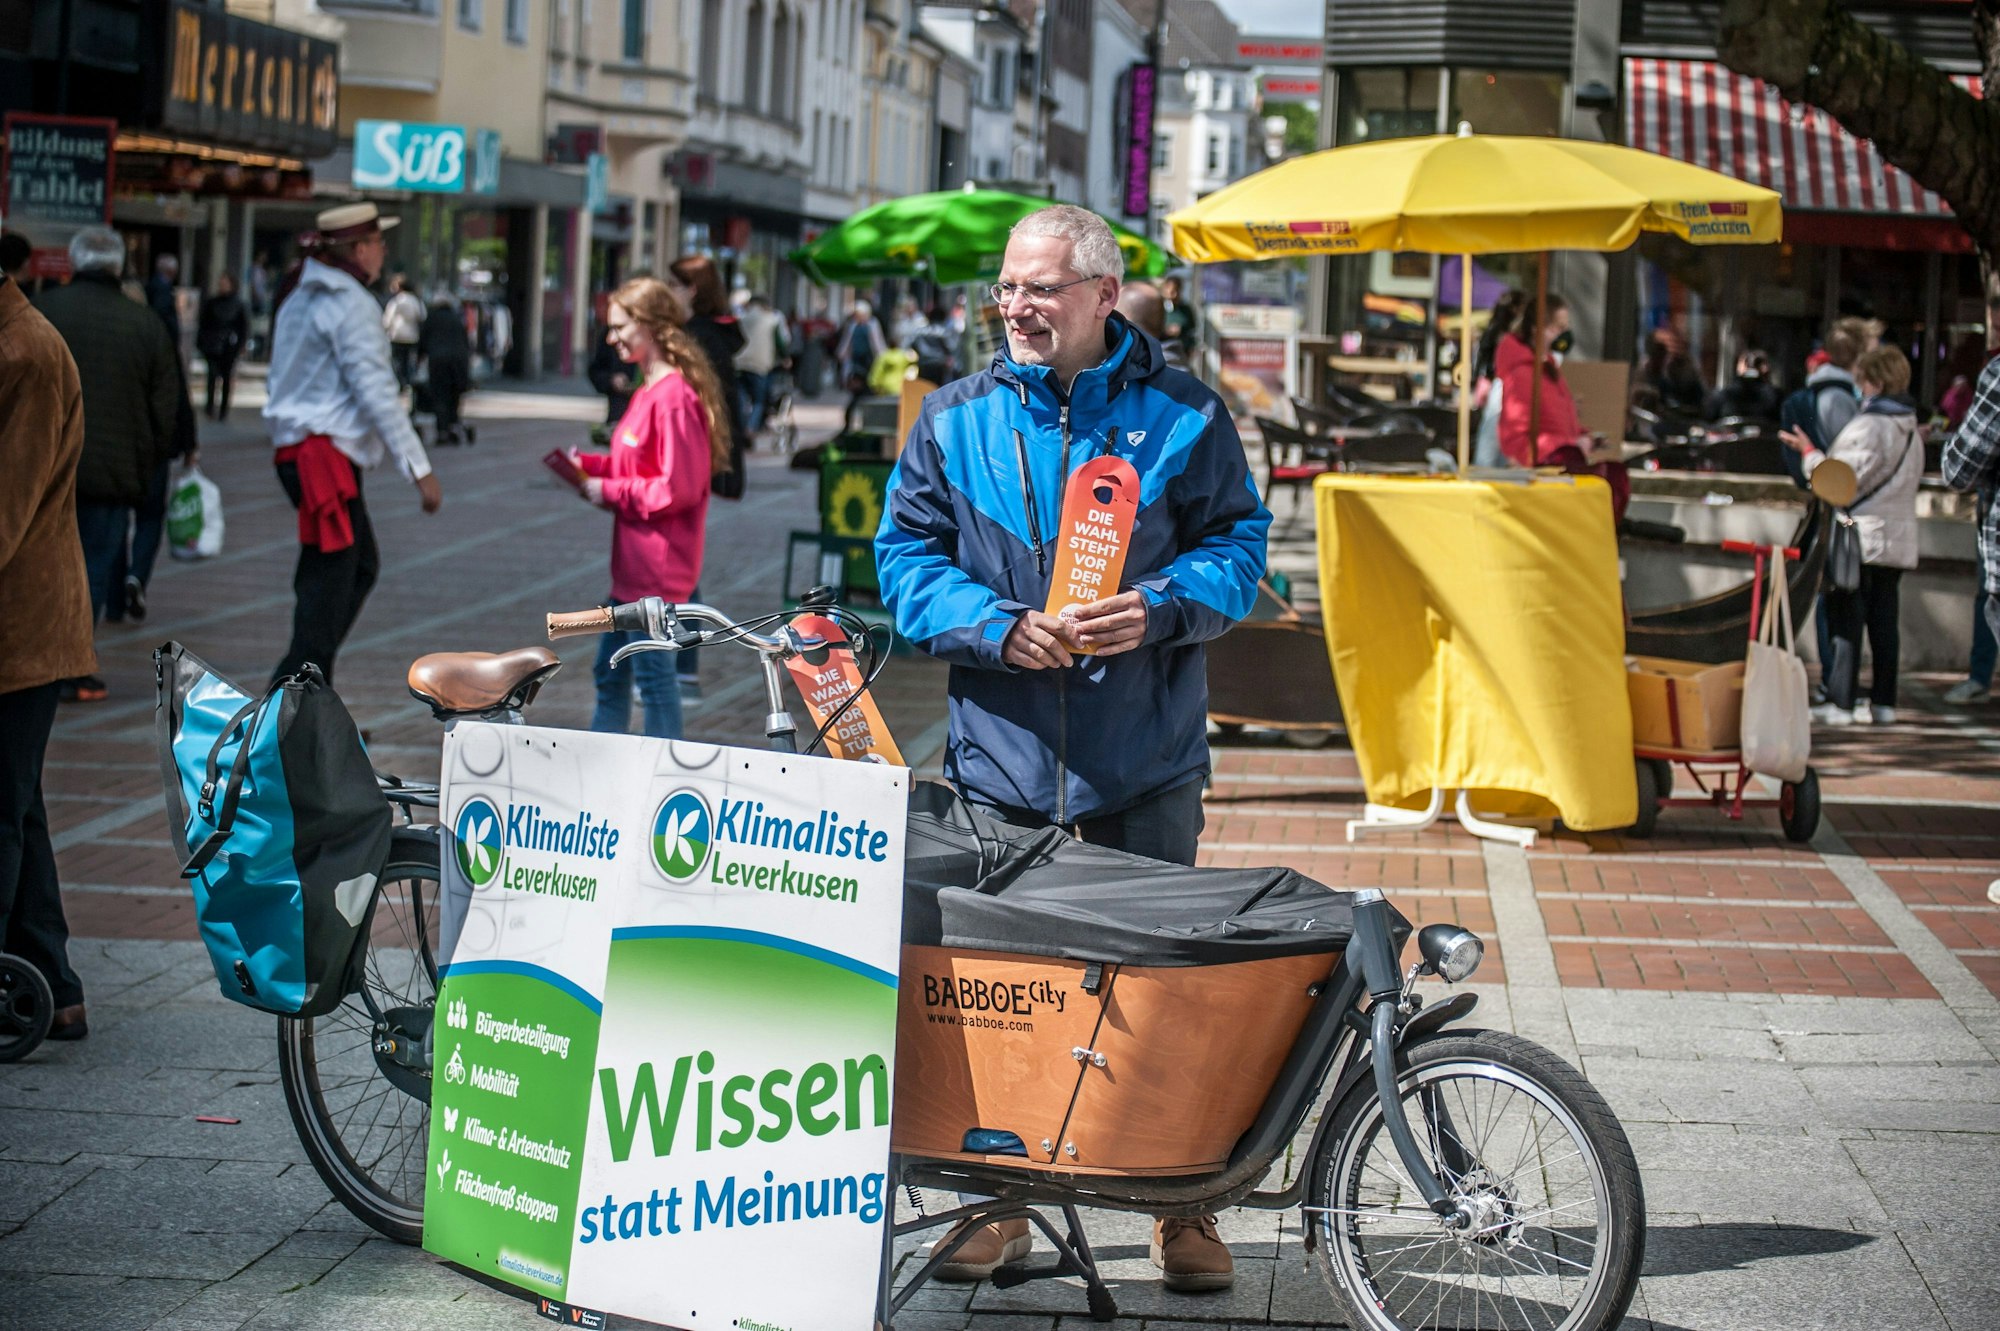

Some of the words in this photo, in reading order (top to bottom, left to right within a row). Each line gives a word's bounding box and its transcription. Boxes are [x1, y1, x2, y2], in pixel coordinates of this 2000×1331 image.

[9, 128, 106, 162] Bildung
[351, 122, 464, 187] Süß
[8, 171, 105, 207] Tablet
[1074, 521, 1121, 544] WAHL
[1088, 509, 1115, 526] DIE
[1069, 536, 1120, 559] STEHT
[1074, 552, 1108, 572] VOR
[1067, 583, 1099, 602] TÜR
[1070, 567, 1103, 586] DER
[811, 679, 857, 703] WAHL
[814, 668, 840, 686] DIE
[838, 720, 869, 740] DER
[844, 735, 876, 754] TÜR
[505, 804, 620, 861] Klimaliste
[715, 798, 889, 862] Klimaliste
[503, 857, 597, 902] Leverkusen
[711, 851, 859, 903] Leverkusen
[924, 974, 1032, 1015] BABBOE
[1029, 980, 1067, 1013] City
[475, 1011, 571, 1060] Bürgerbeteiligung
[927, 1013, 1034, 1033] www.babboe.com
[470, 1064, 520, 1098] Mobilität
[598, 1050, 889, 1163] Wissen
[463, 1116, 498, 1147] Klima-
[497, 1126, 508, 1151] &
[507, 1129, 572, 1169] Artenschutz
[454, 1169, 517, 1212] Flächenfraß
[515, 1191, 559, 1223] stoppen
[579, 1187, 682, 1244] statt
[693, 1170, 885, 1232] Meinung
